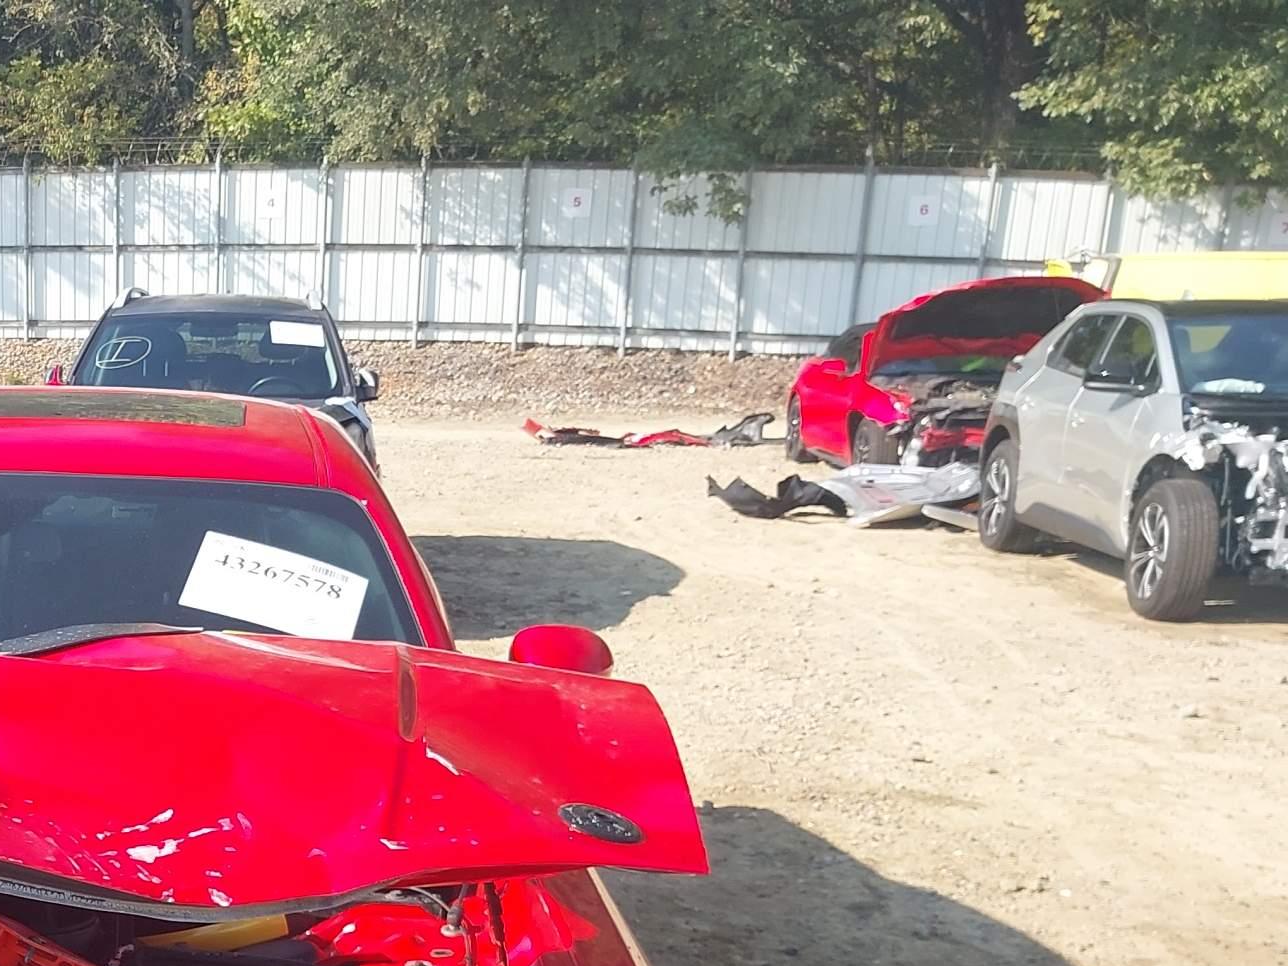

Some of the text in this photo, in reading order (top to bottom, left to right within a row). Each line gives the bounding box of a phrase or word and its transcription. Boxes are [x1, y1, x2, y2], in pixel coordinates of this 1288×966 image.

[573, 196, 582, 207] 5
[920, 204, 929, 215] 6
[214, 554, 342, 599] 43267578
